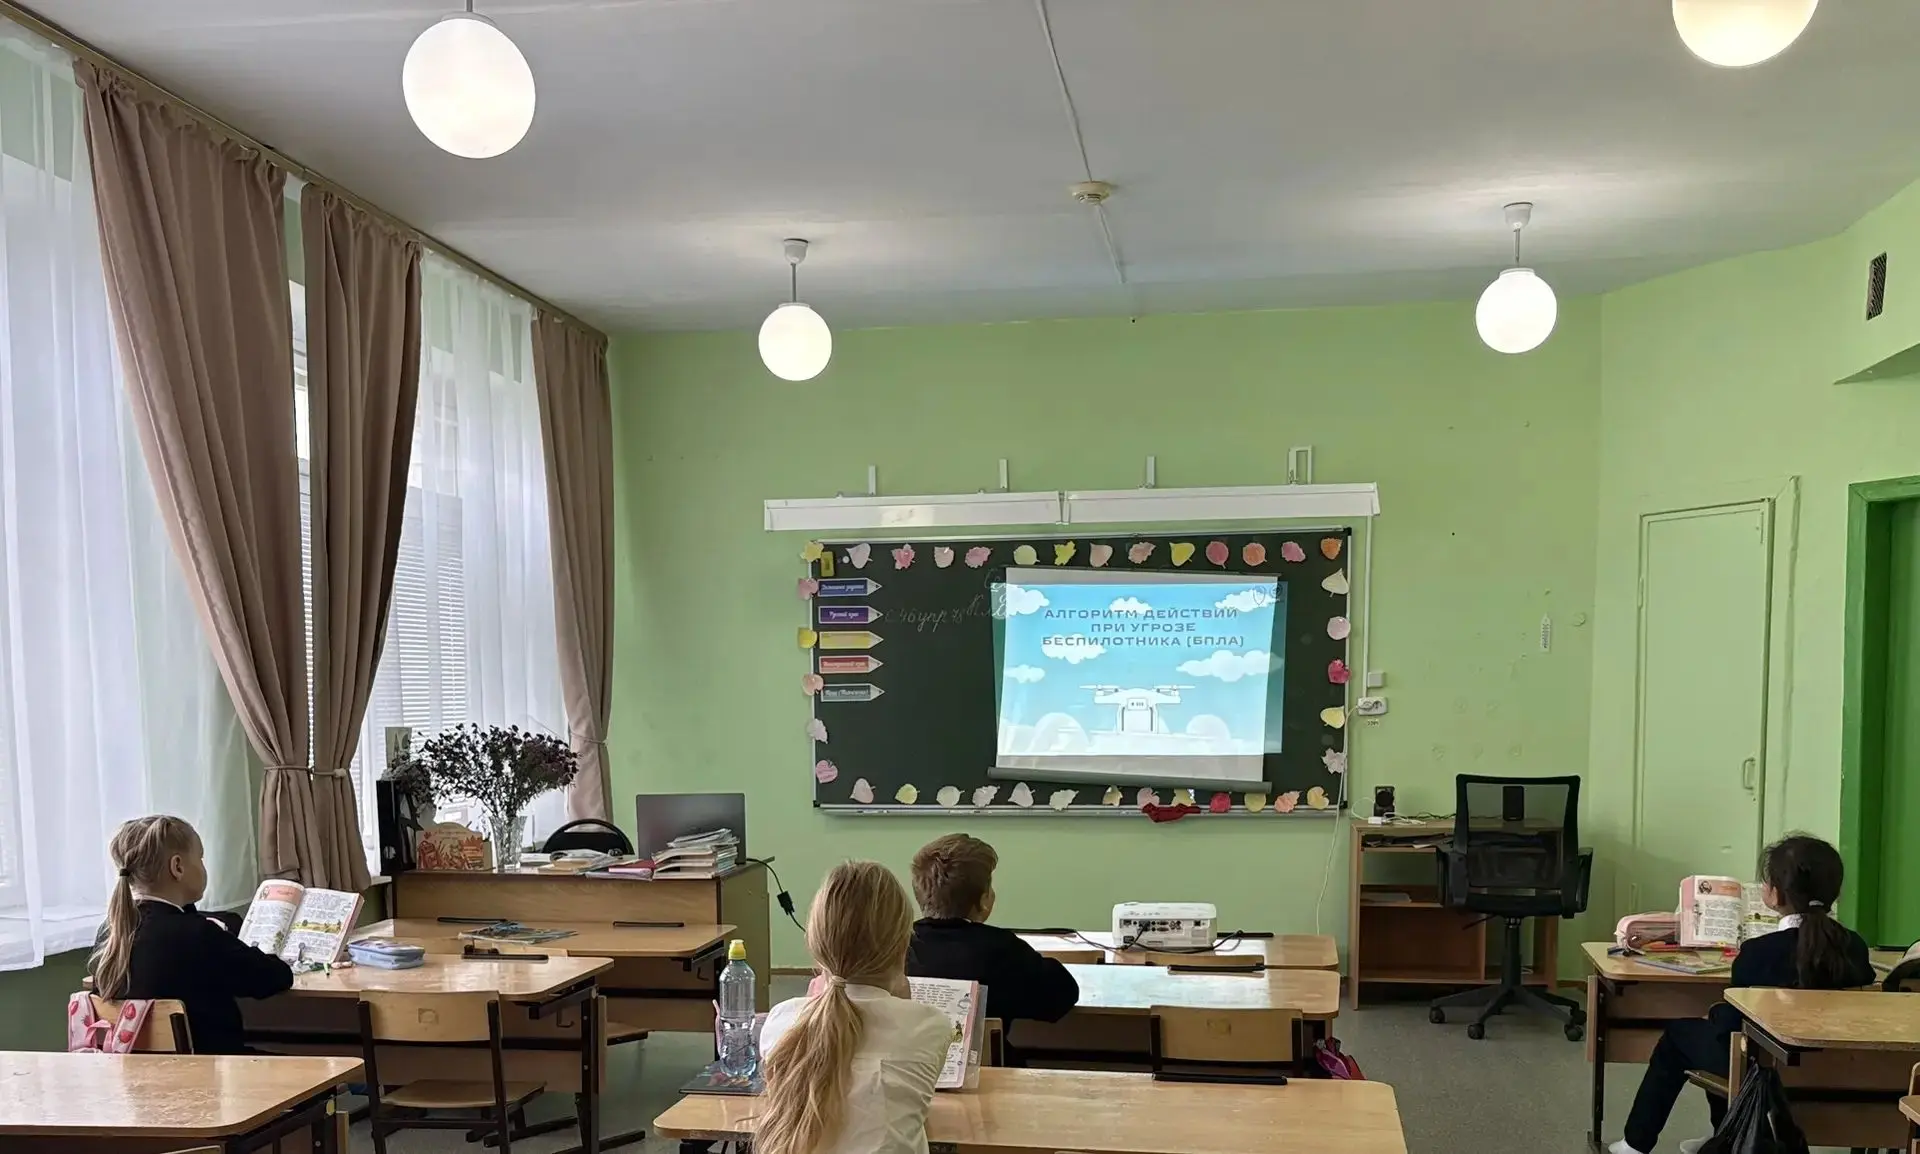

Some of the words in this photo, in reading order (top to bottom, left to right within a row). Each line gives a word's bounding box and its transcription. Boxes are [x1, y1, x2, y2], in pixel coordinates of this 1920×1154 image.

[1044, 609, 1138, 619] АЛГОРИТМ
[1143, 606, 1237, 620] ДЕЙСТВИЙ
[1091, 623, 1125, 633] ПРИ
[1131, 622, 1196, 633] УГРОЗЕ
[1042, 636, 1181, 646] БЕСПИЛОТНИКА
[1187, 635, 1244, 647] (БПЛА)
